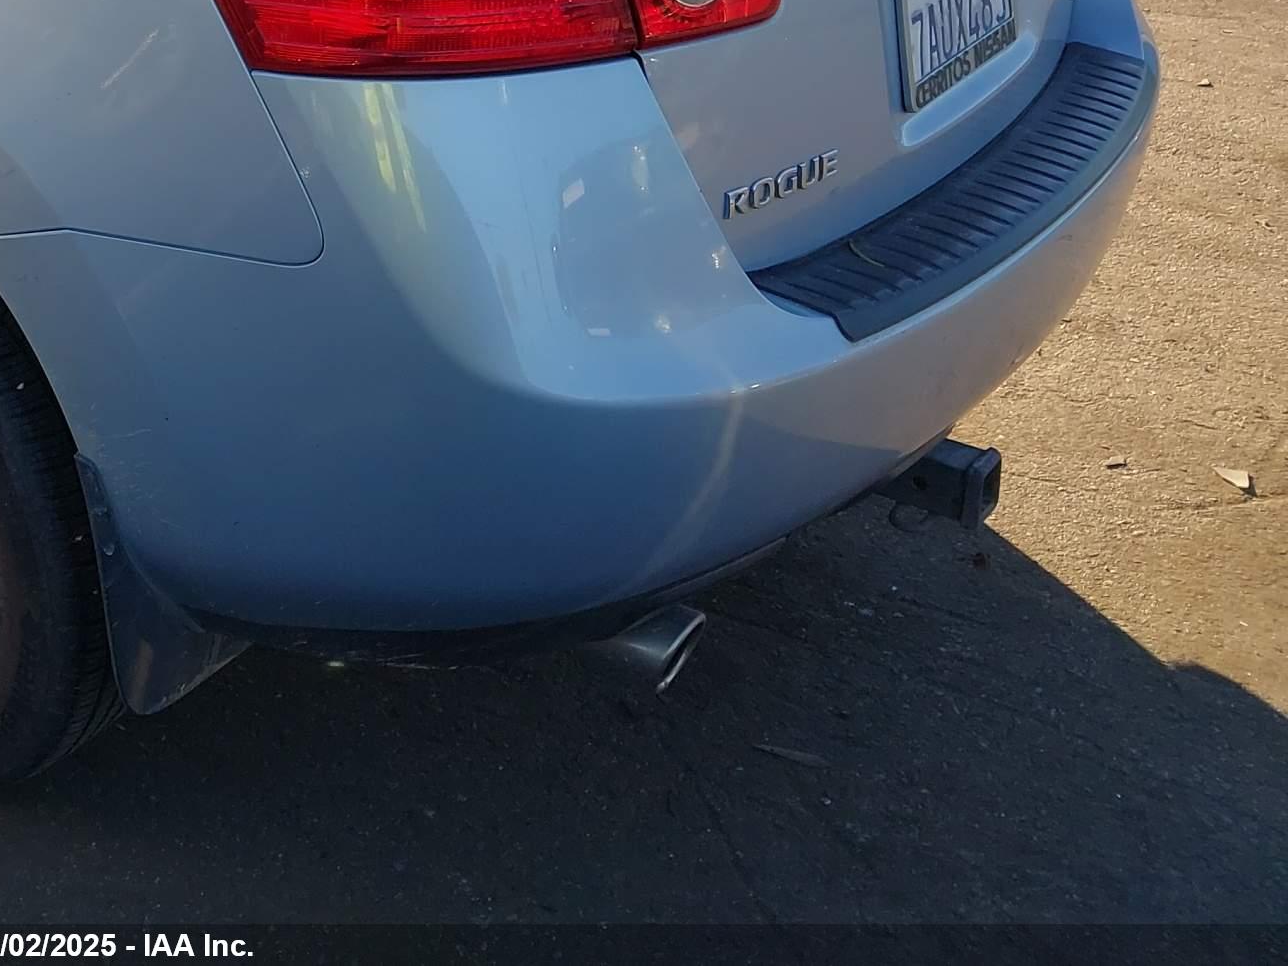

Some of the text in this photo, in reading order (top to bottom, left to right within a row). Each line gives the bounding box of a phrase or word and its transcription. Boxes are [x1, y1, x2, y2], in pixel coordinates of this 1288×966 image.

[916, 19, 1017, 109] CERRITOS NISSAN
[723, 147, 838, 220] ROGUE
